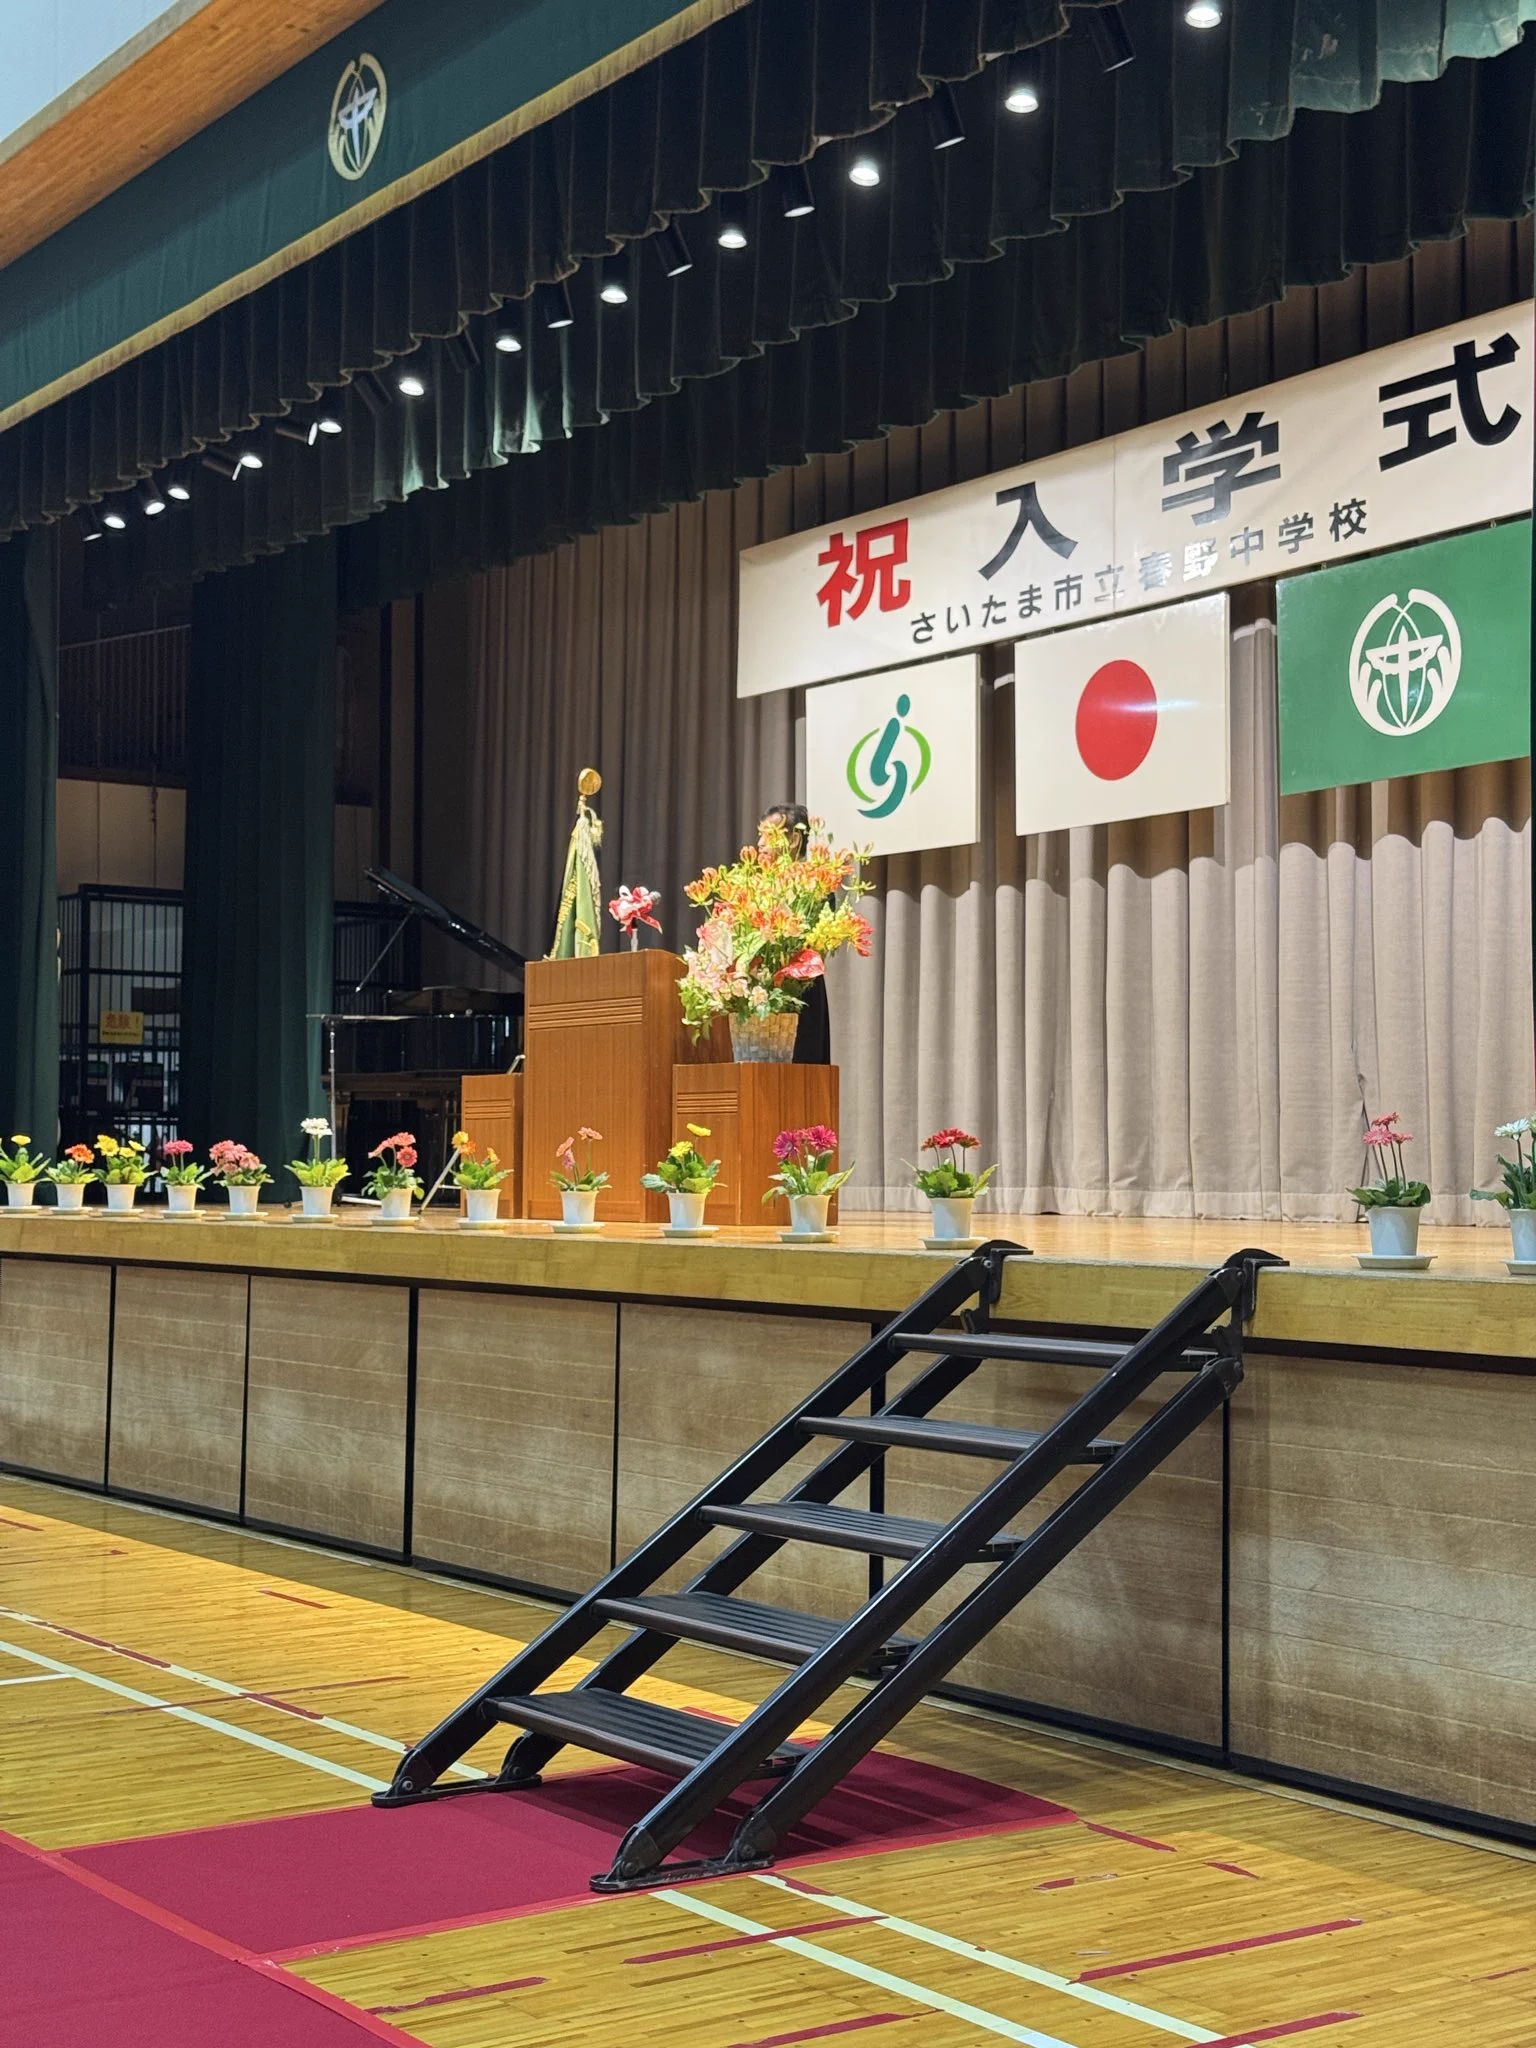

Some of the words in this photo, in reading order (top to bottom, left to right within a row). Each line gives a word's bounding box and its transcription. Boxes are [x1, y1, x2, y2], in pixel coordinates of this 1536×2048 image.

[911, 498, 1368, 645] さいたま市立春野中学校
